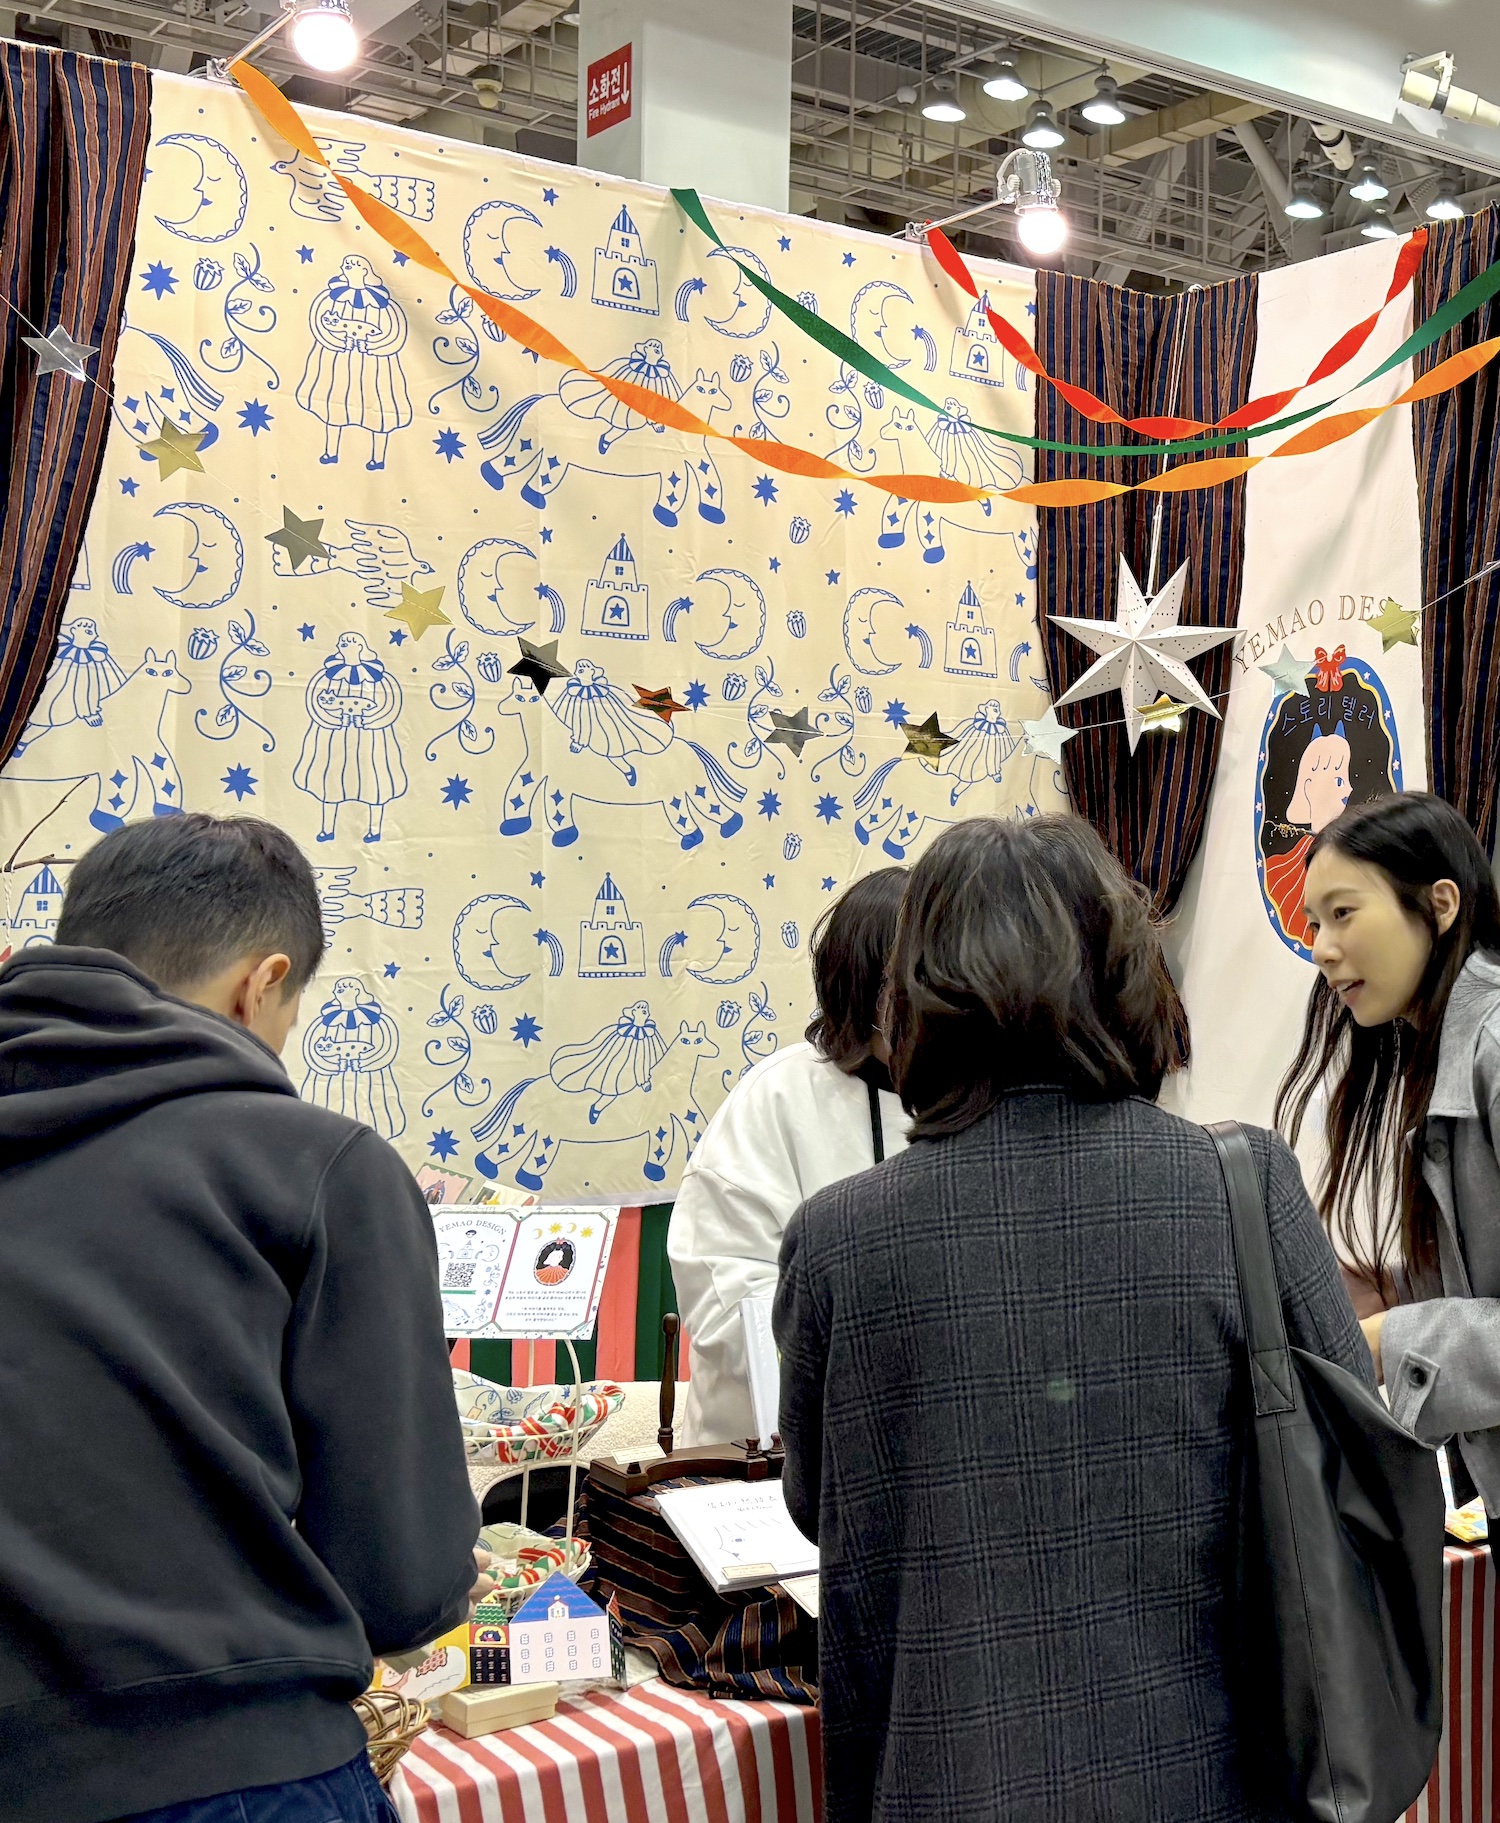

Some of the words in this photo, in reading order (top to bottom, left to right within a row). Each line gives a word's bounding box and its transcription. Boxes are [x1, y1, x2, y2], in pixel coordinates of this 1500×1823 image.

[589, 64, 620, 105] 소화전
[588, 108, 599, 120] Fire
[600, 96, 620, 115] Hydrant
[1232, 600, 1325, 674] YEMAO
[439, 1219, 473, 1232] YEMAO
[475, 1219, 507, 1235] DESIGN
